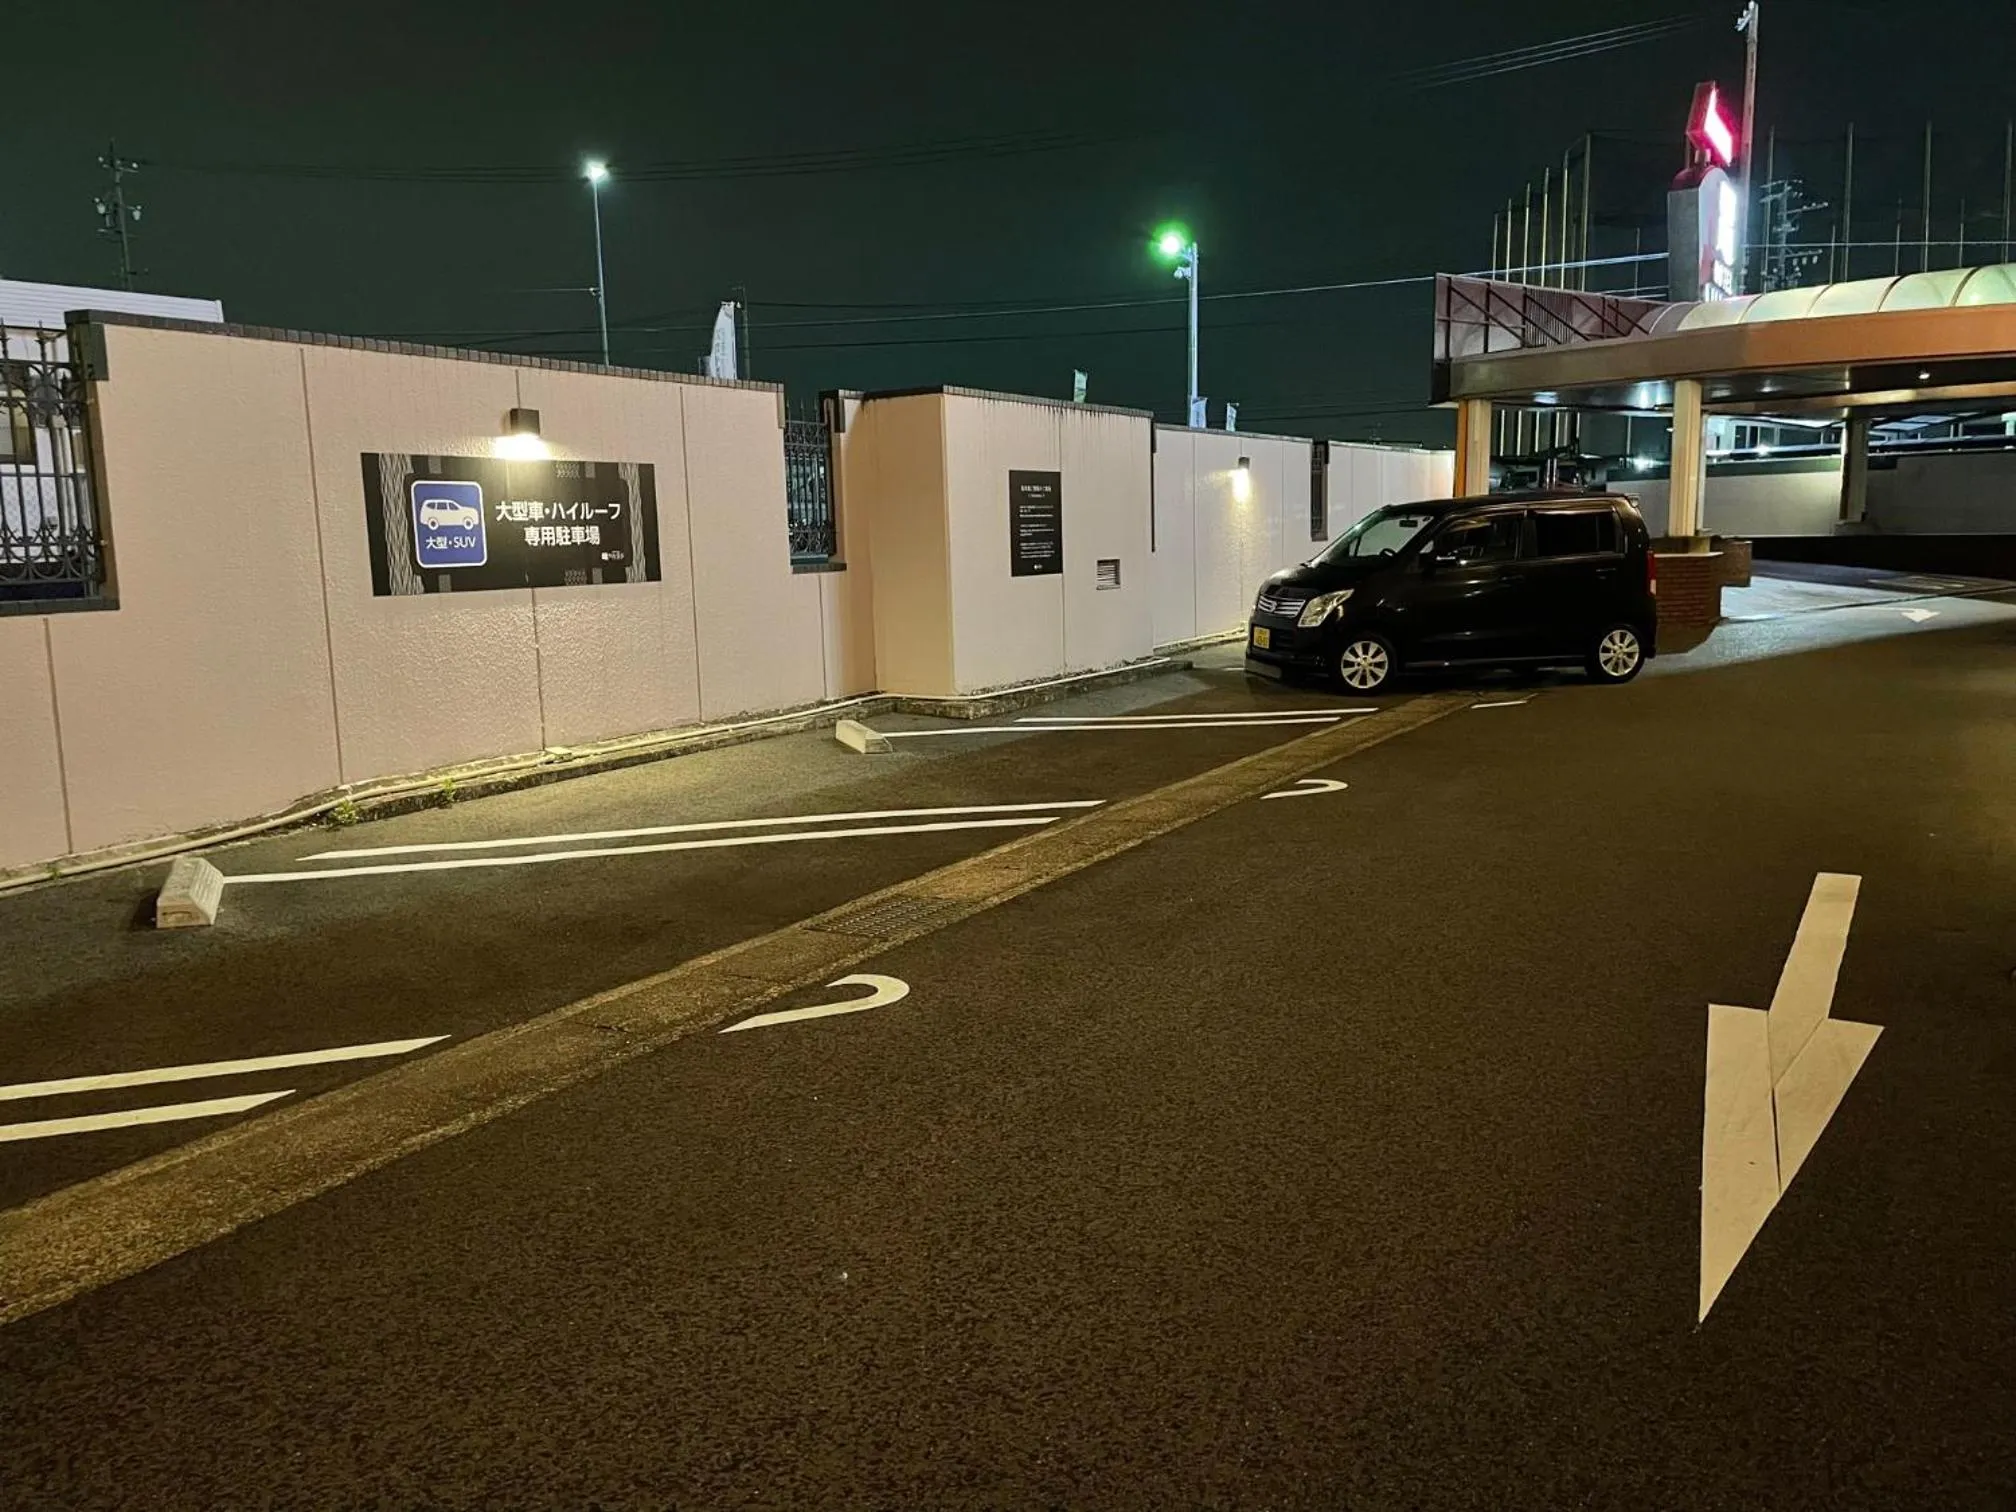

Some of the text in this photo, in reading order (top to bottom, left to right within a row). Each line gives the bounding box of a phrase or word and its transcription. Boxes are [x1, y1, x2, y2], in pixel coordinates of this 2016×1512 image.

[495, 501, 621, 521] 大型車・ハイルーフ
[426, 535, 476, 549] 大型・SUV
[524, 525, 600, 546] 専用駐車場
